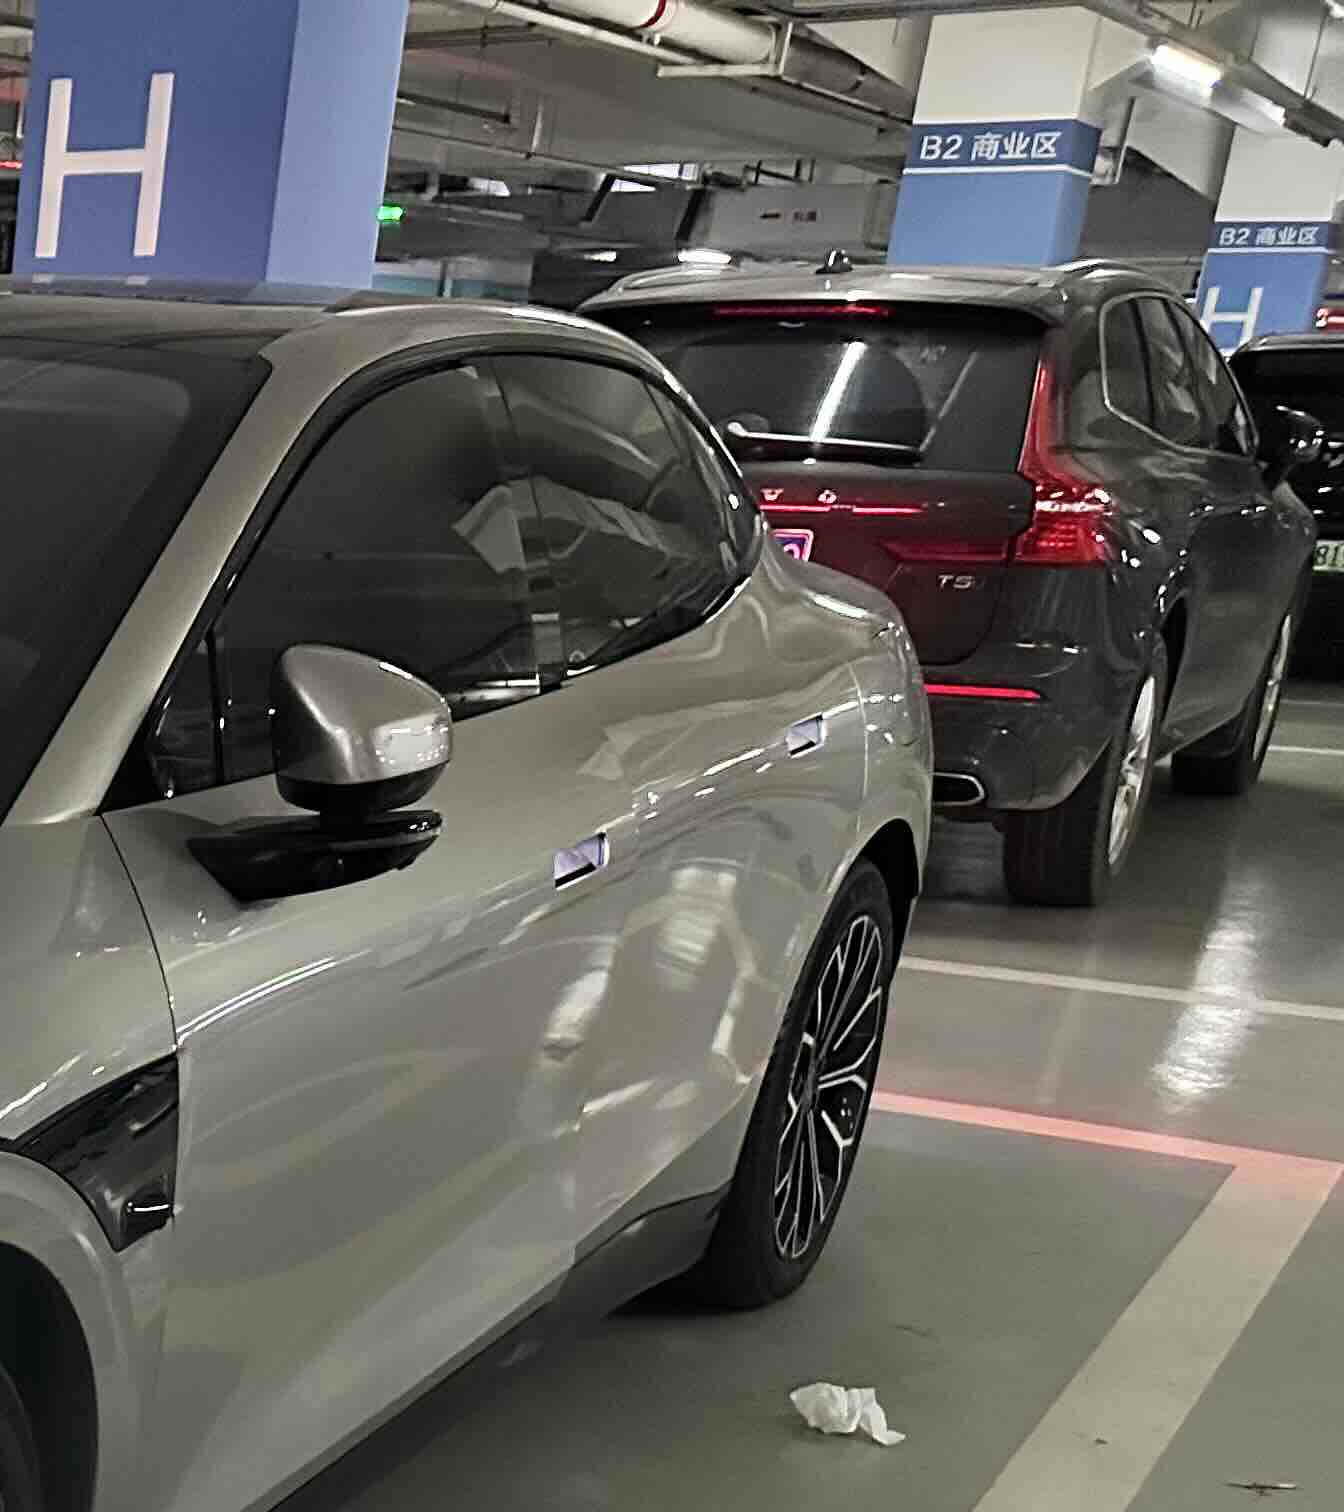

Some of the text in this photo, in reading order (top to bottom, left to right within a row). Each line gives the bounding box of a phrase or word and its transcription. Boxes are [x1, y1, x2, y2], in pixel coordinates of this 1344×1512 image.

[35, 73, 175, 258] H
[920, 131, 1062, 161] B2 商业区
[1219, 226, 1319, 246] B2 商业区
[1200, 287, 1264, 347] H
